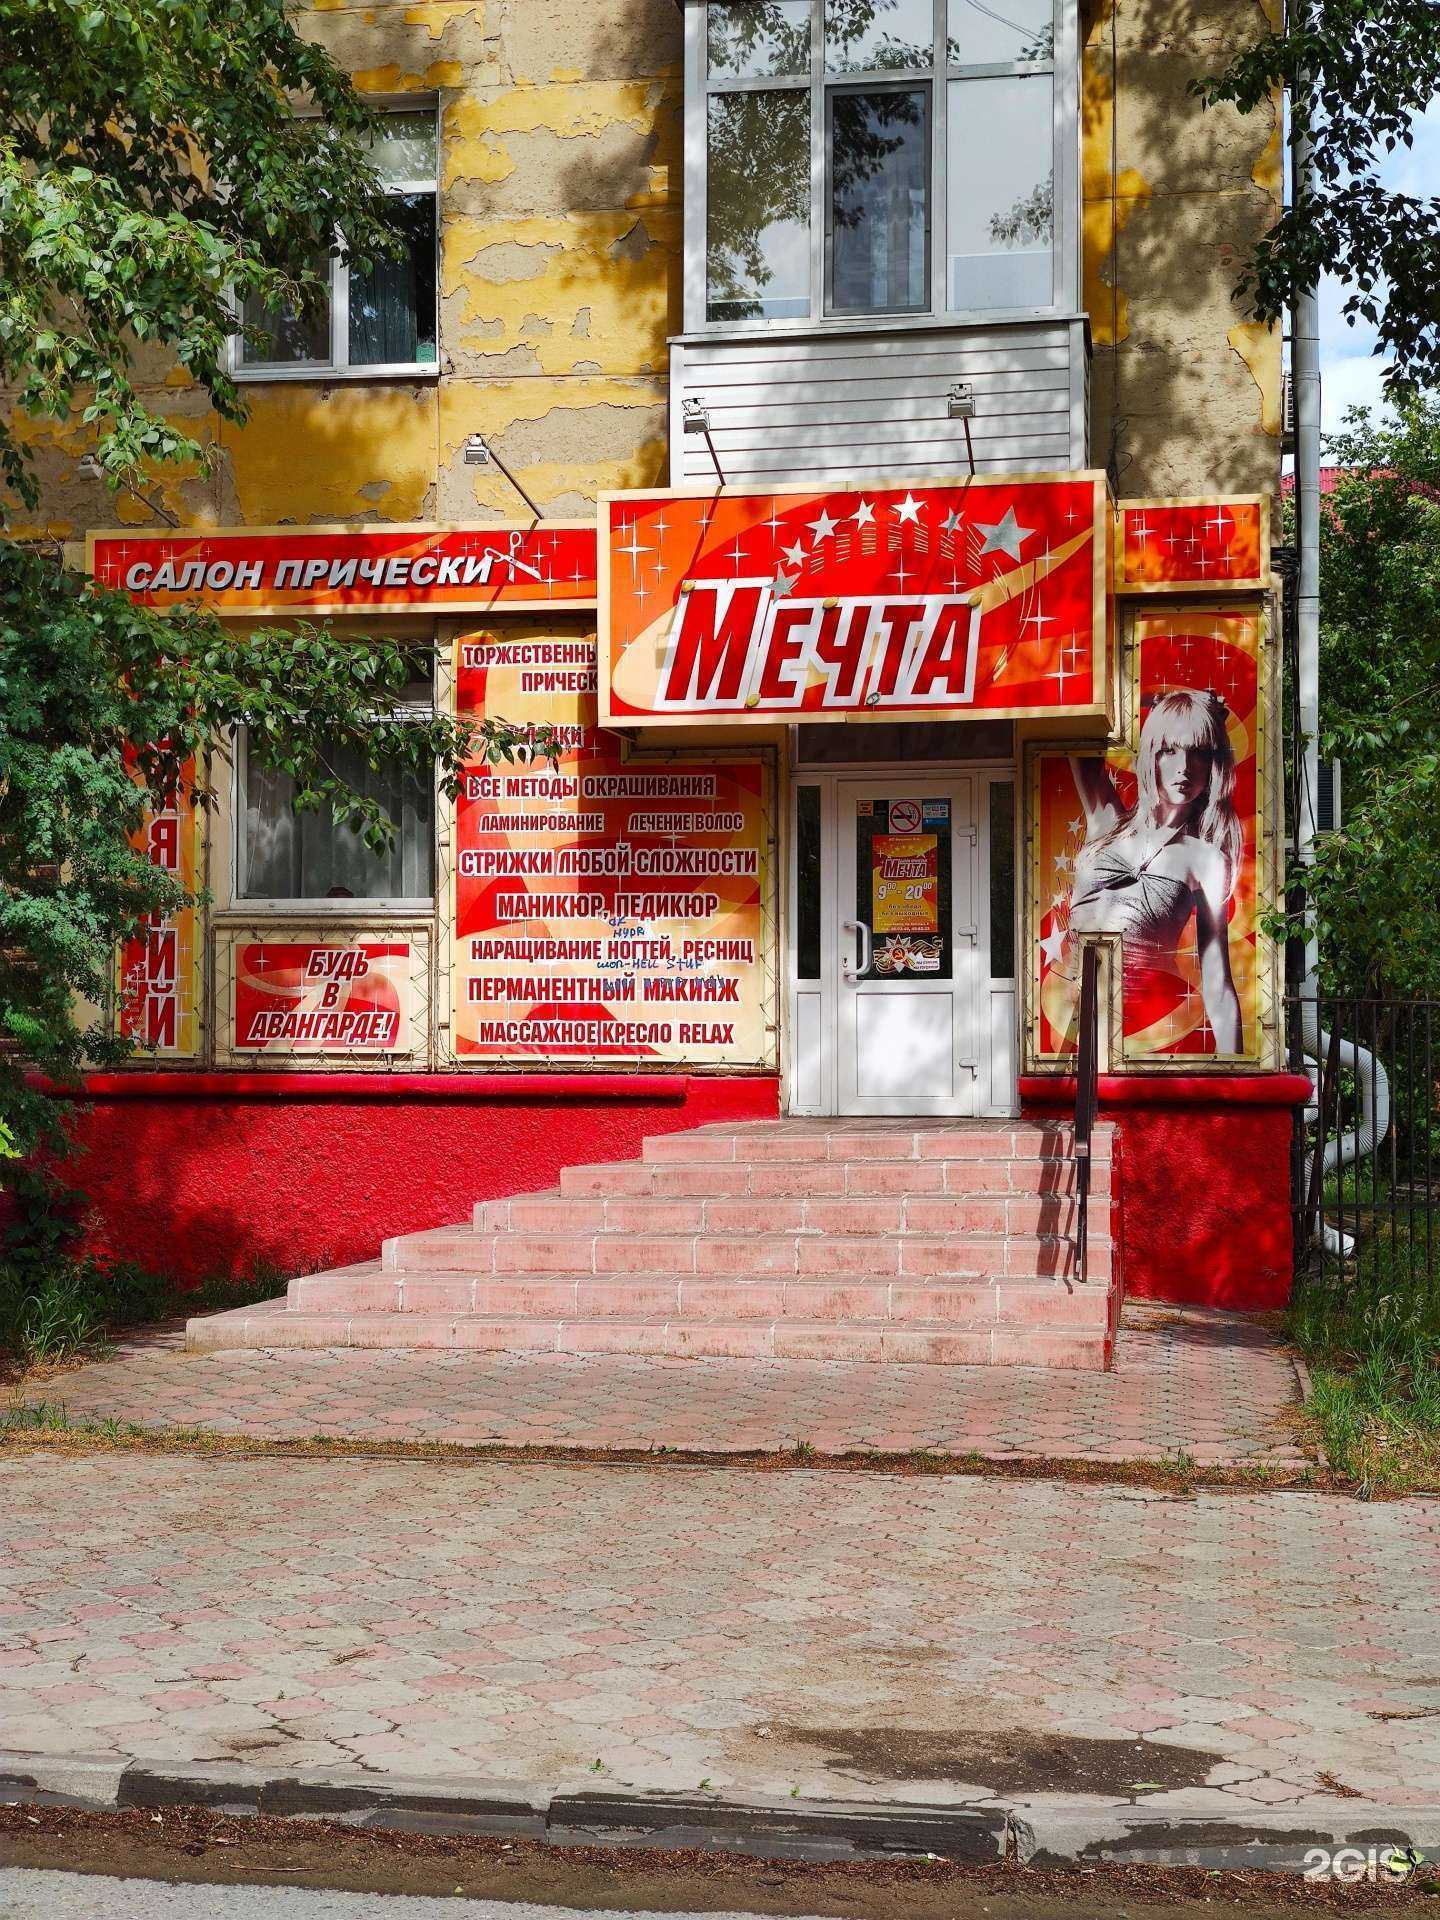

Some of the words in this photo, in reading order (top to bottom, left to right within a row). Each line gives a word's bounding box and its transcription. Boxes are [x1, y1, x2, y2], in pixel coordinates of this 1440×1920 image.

[125, 560, 265, 591] САЛОН
[273, 555, 494, 588] ПРИЧЕСКИ
[522, 671, 598, 691] ПРИЧЕСК
[469, 777, 500, 798] ВСЕ
[506, 777, 577, 799] МЕТОДЫ
[584, 775, 714, 798] ОКРАШИВАНИЯ
[481, 814, 602, 831] ЛАМИНИРОВАНИЕ
[629, 813, 691, 831] ЛЕЧЕНИЕ
[694, 813, 743, 831] ВОЛОС
[461, 851, 553, 873] СТРИЖКИ
[558, 845, 630, 873] ЛЮБОЙ
[635, 849, 757, 873] СЛОЖНОСТИ
[498, 895, 609, 920] МАНИКЮР,
[616, 894, 718, 920] ПЕДИКЮР
[472, 941, 601, 963] НАРАЩИВАНИЕ
[683, 940, 753, 963] РЕСНИЦ
[307, 950, 368, 980] БУДЬ
[322, 982, 338, 1008] В
[469, 972, 635, 1001] ПЕРМАНЕНТНЫЙ
[644, 978, 739, 1001] МАКИЯЖ
[250, 1012, 396, 1042] АВАНГАРДЕ!
[480, 1022, 596, 1043] МАССАЖНОЕ
[603, 1022, 672, 1044] КРЕСЛО
[679, 1022, 734, 1044] RELAX
